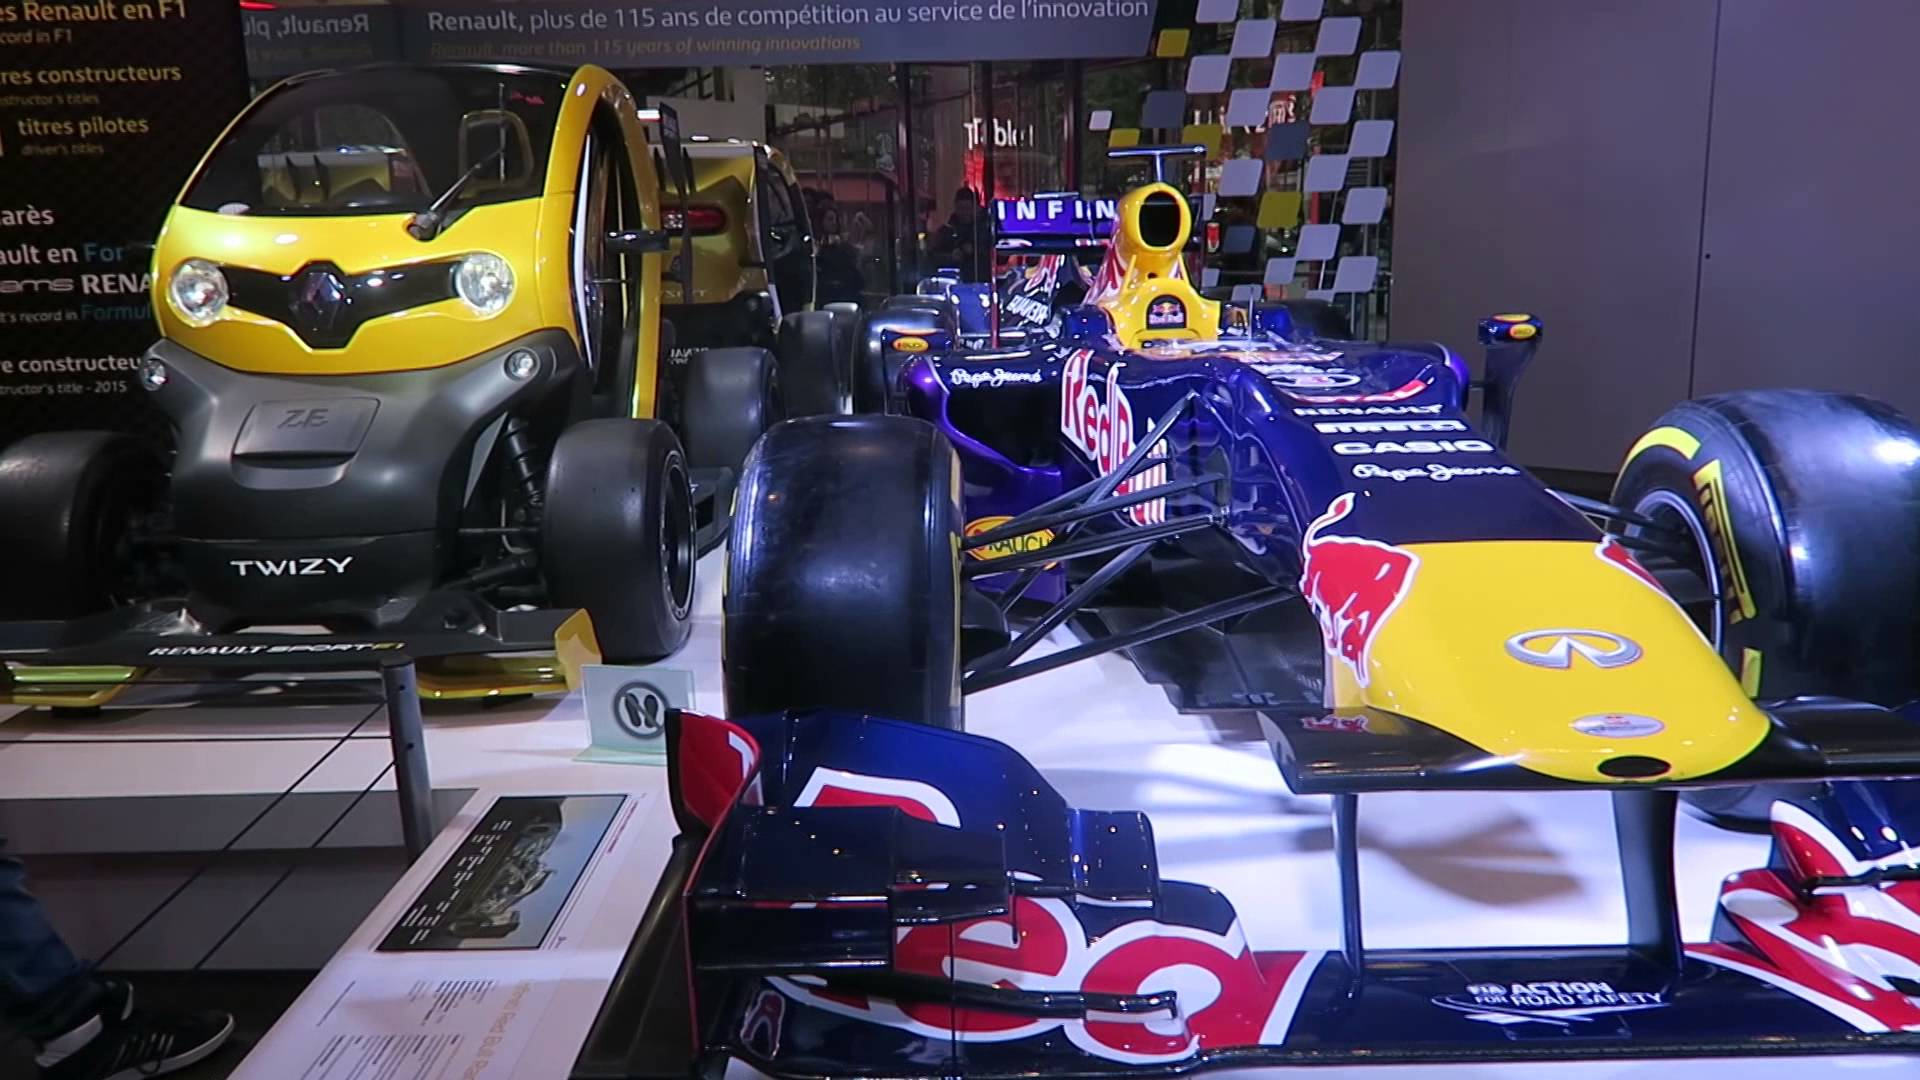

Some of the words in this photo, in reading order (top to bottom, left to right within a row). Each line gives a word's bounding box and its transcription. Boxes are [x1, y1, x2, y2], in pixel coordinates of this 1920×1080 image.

[24, 0, 118, 22] Renault
[123, 4, 153, 20] en
[159, 1, 187, 20] F1
[428, 10, 524, 33] Renault,
[530, 9, 575, 35] plus
[580, 8, 607, 29] de
[615, 8, 655, 28] 115
[661, 11, 700, 28] ans
[705, 6, 732, 27] de
[738, 3, 870, 30] compétition
[875, 6, 901, 23] au
[907, 2, 983, 23] service
[989, 0, 1016, 21] de
[1021, 0, 1149, 20] l'innovation
[36, 30, 51, 44] in
[54, 29, 72, 44] F1
[548, 40, 586, 55] than
[594, 39, 621, 54] 115
[626, 39, 672, 58] years
[676, 38, 694, 55] of
[697, 37, 761, 55] winning
[766, 36, 861, 53] innovations
[37, 65, 183, 85] constructeurs
[18, 118, 74, 136] titres
[79, 116, 150, 138] pilotes
[47, 247, 79, 263] en
[19, 310, 62, 323] record
[65, 309, 78, 321] in
[57, 382, 83, 394] title
[95, 380, 128, 393] 2015
[1292, 404, 1444, 417] RENAULT
[1332, 440, 1496, 456] CASIO
[230, 556, 353, 577] TWIZY
[148, 645, 267, 656] RENAULT
[1511, 981, 1615, 997] ACTION
[1509, 994, 1576, 1007] ROAD
[1576, 992, 1663, 1005] SAFETY
